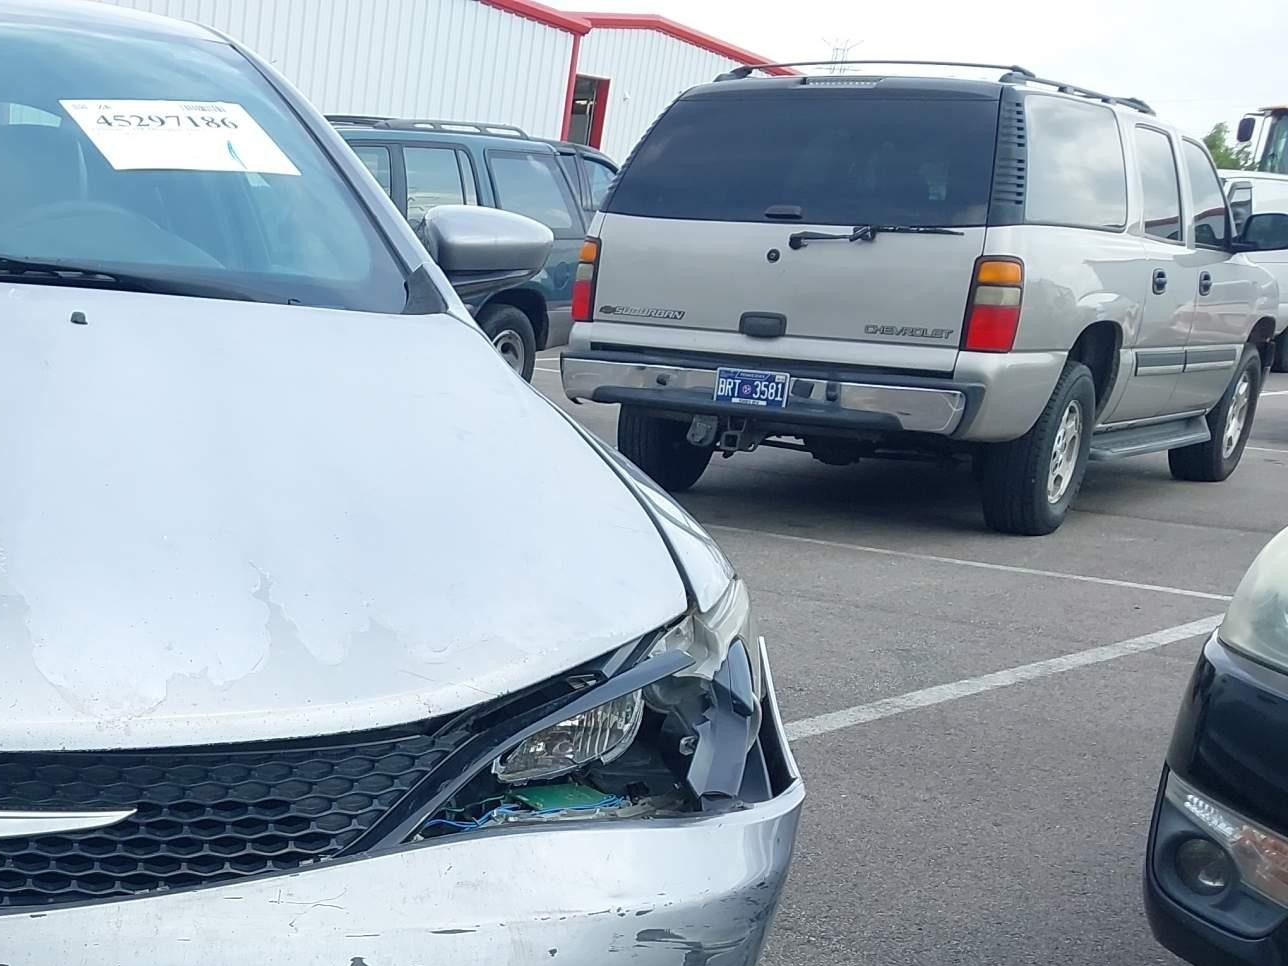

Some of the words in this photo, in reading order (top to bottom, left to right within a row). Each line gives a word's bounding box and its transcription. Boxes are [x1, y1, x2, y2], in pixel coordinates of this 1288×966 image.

[96, 114, 239, 129] 45297186
[864, 325, 953, 339] CHEVROLET
[717, 378, 741, 397] BRT
[752, 380, 783, 401] 3581
